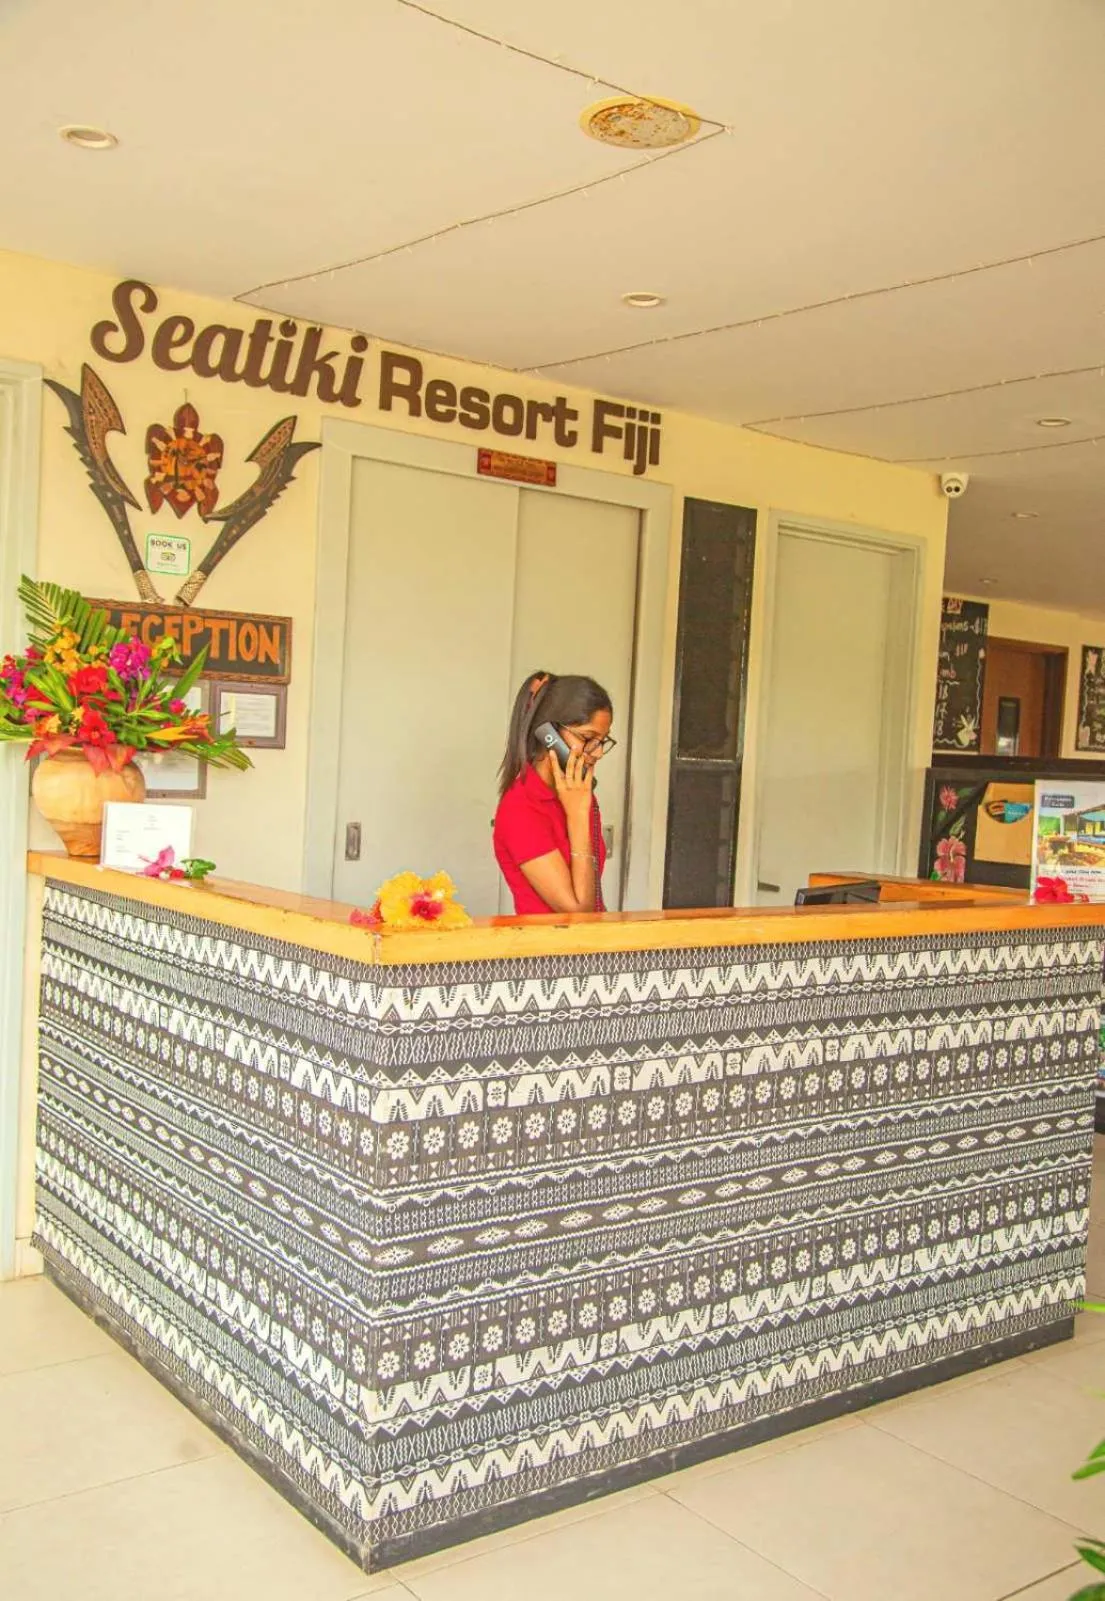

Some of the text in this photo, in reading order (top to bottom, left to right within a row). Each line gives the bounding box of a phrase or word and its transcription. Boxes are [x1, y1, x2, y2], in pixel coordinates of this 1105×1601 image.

[91, 280, 661, 476] Seatiki Resort Fiji
